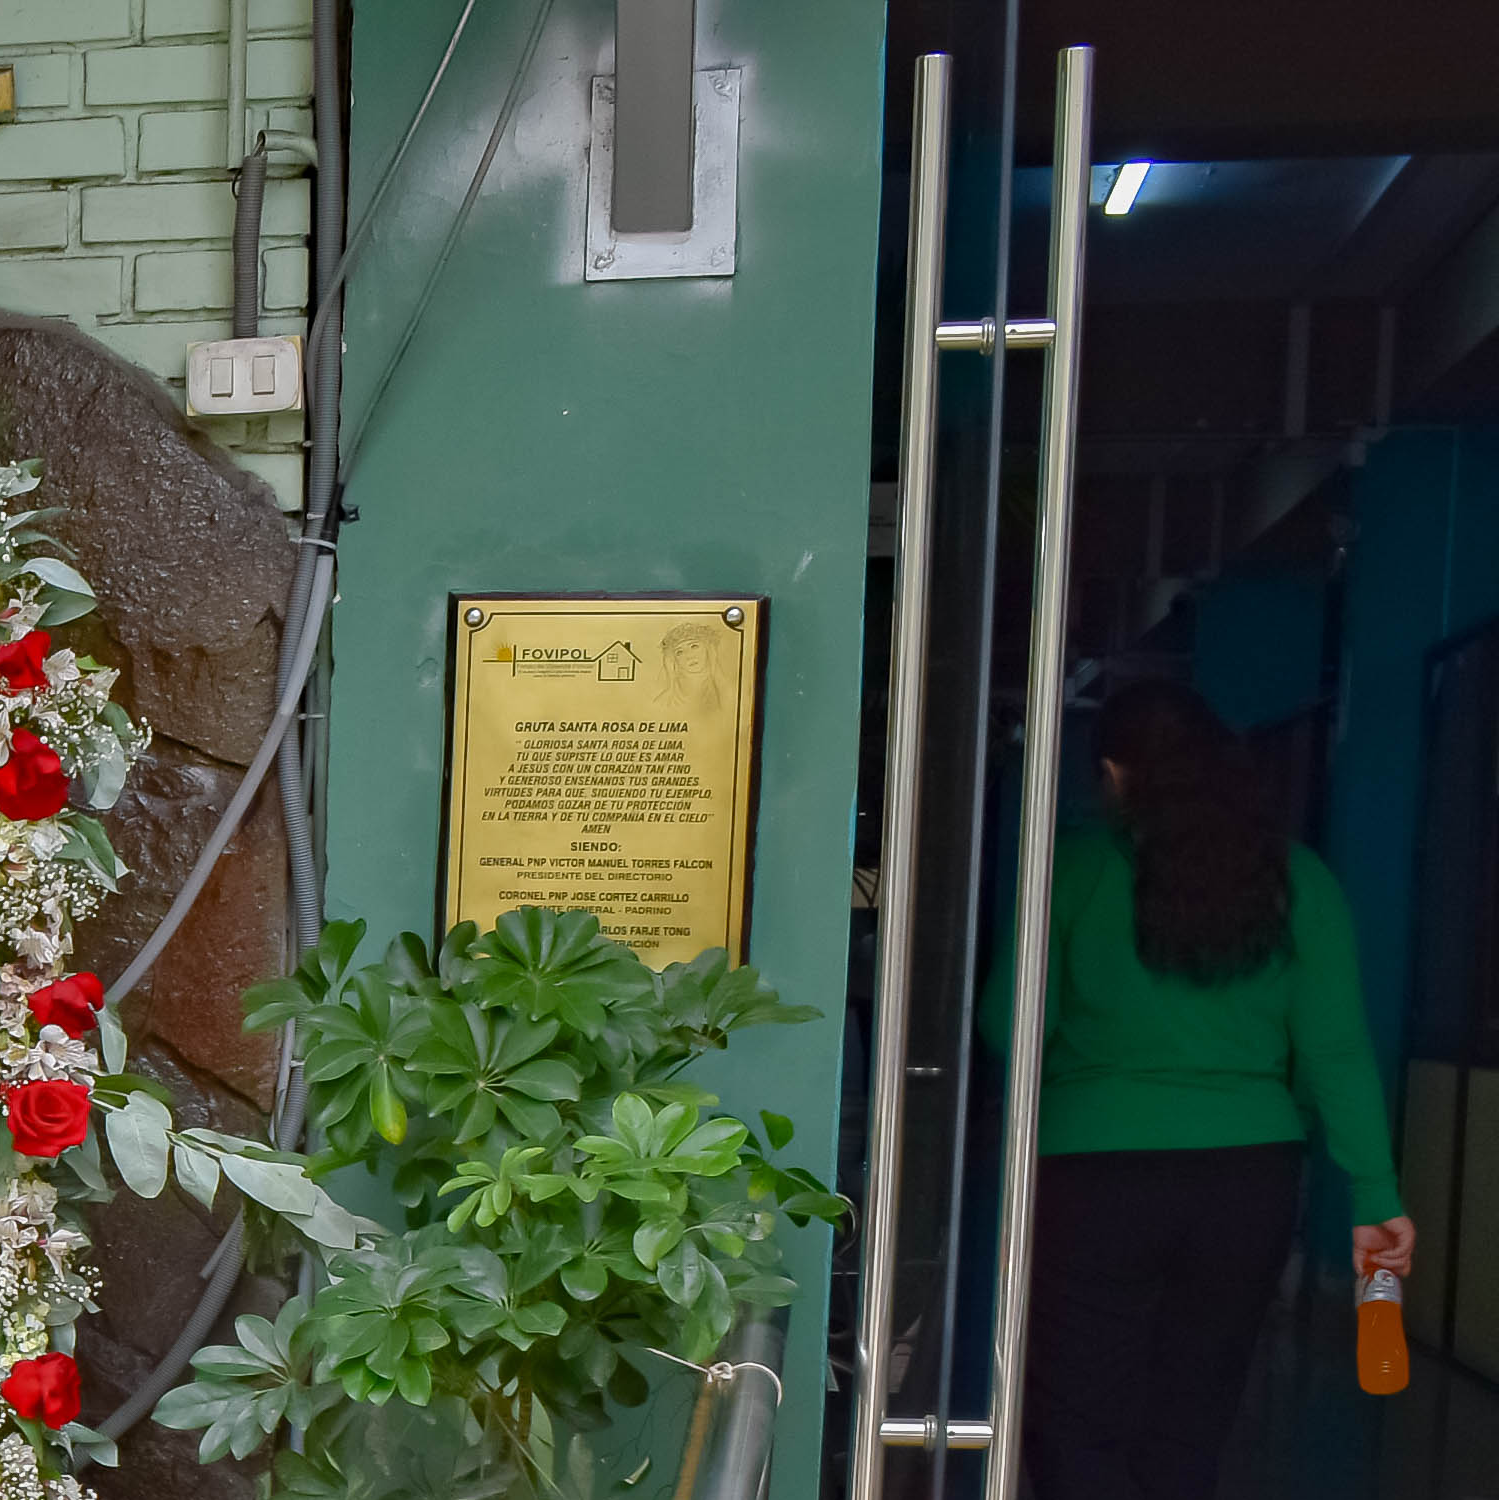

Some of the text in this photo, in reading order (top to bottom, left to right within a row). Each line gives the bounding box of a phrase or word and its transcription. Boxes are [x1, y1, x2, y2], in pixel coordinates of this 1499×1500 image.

[522, 648, 592, 660] FOVIPOL
[515, 722, 688, 732] GRUTA SANTA ROSA DE LIMA
[524, 740, 574, 750] GLORIOSA
[576, 740, 608, 750] SANTA
[611, 740, 639, 750] ROSA
[642, 740, 657, 750] DE
[516, 752, 684, 762] TU QUE SUPISTE LO QUE ES AMAR
[508, 764, 515, 773] A
[552, 764, 574, 773] CON
[576, 764, 591, 773] UN
[645, 764, 664, 774] TAN
[667, 764, 691, 774] FINO
[500, 776, 506, 785] Y
[508, 776, 562, 785] GENEROSO
[629, 777, 648, 786] TUS
[651, 777, 700, 786] GRANDES
[484, 788, 533, 797] VIRTUDES
[536, 788, 562, 797] PARA
[591, 788, 646, 798] SIGUIENDO
[650, 789, 663, 798] TU
[504, 800, 554, 809] PODAMOS
[558, 800, 591, 810] GOZAR
[594, 800, 608, 810] DE
[610, 801, 623, 810] TU
[482, 811, 495, 821] EN
[497, 811, 510, 821] LA
[513, 812, 548, 821] TIERRA
[552, 812, 558, 821] Y
[560, 812, 573, 821] DE
[577, 812, 590, 821] TU
[648, 813, 661, 822] EN
[664, 813, 675, 822] EL
[581, 824, 611, 834] AMEN
[570, 842, 622, 852] SIENDO:
[479, 857, 713, 869] GENERAL PNP VICTOR MANUEL TORRES FALCON
[516, 872, 672, 881] PRESIDENTE DEL DIRECTORIO
[499, 891, 689, 902] CORONEL PNP JOSE CORTEZ CARRILLO
[625, 906, 672, 915] PADRINO
[663, 927, 691, 936] TONG
